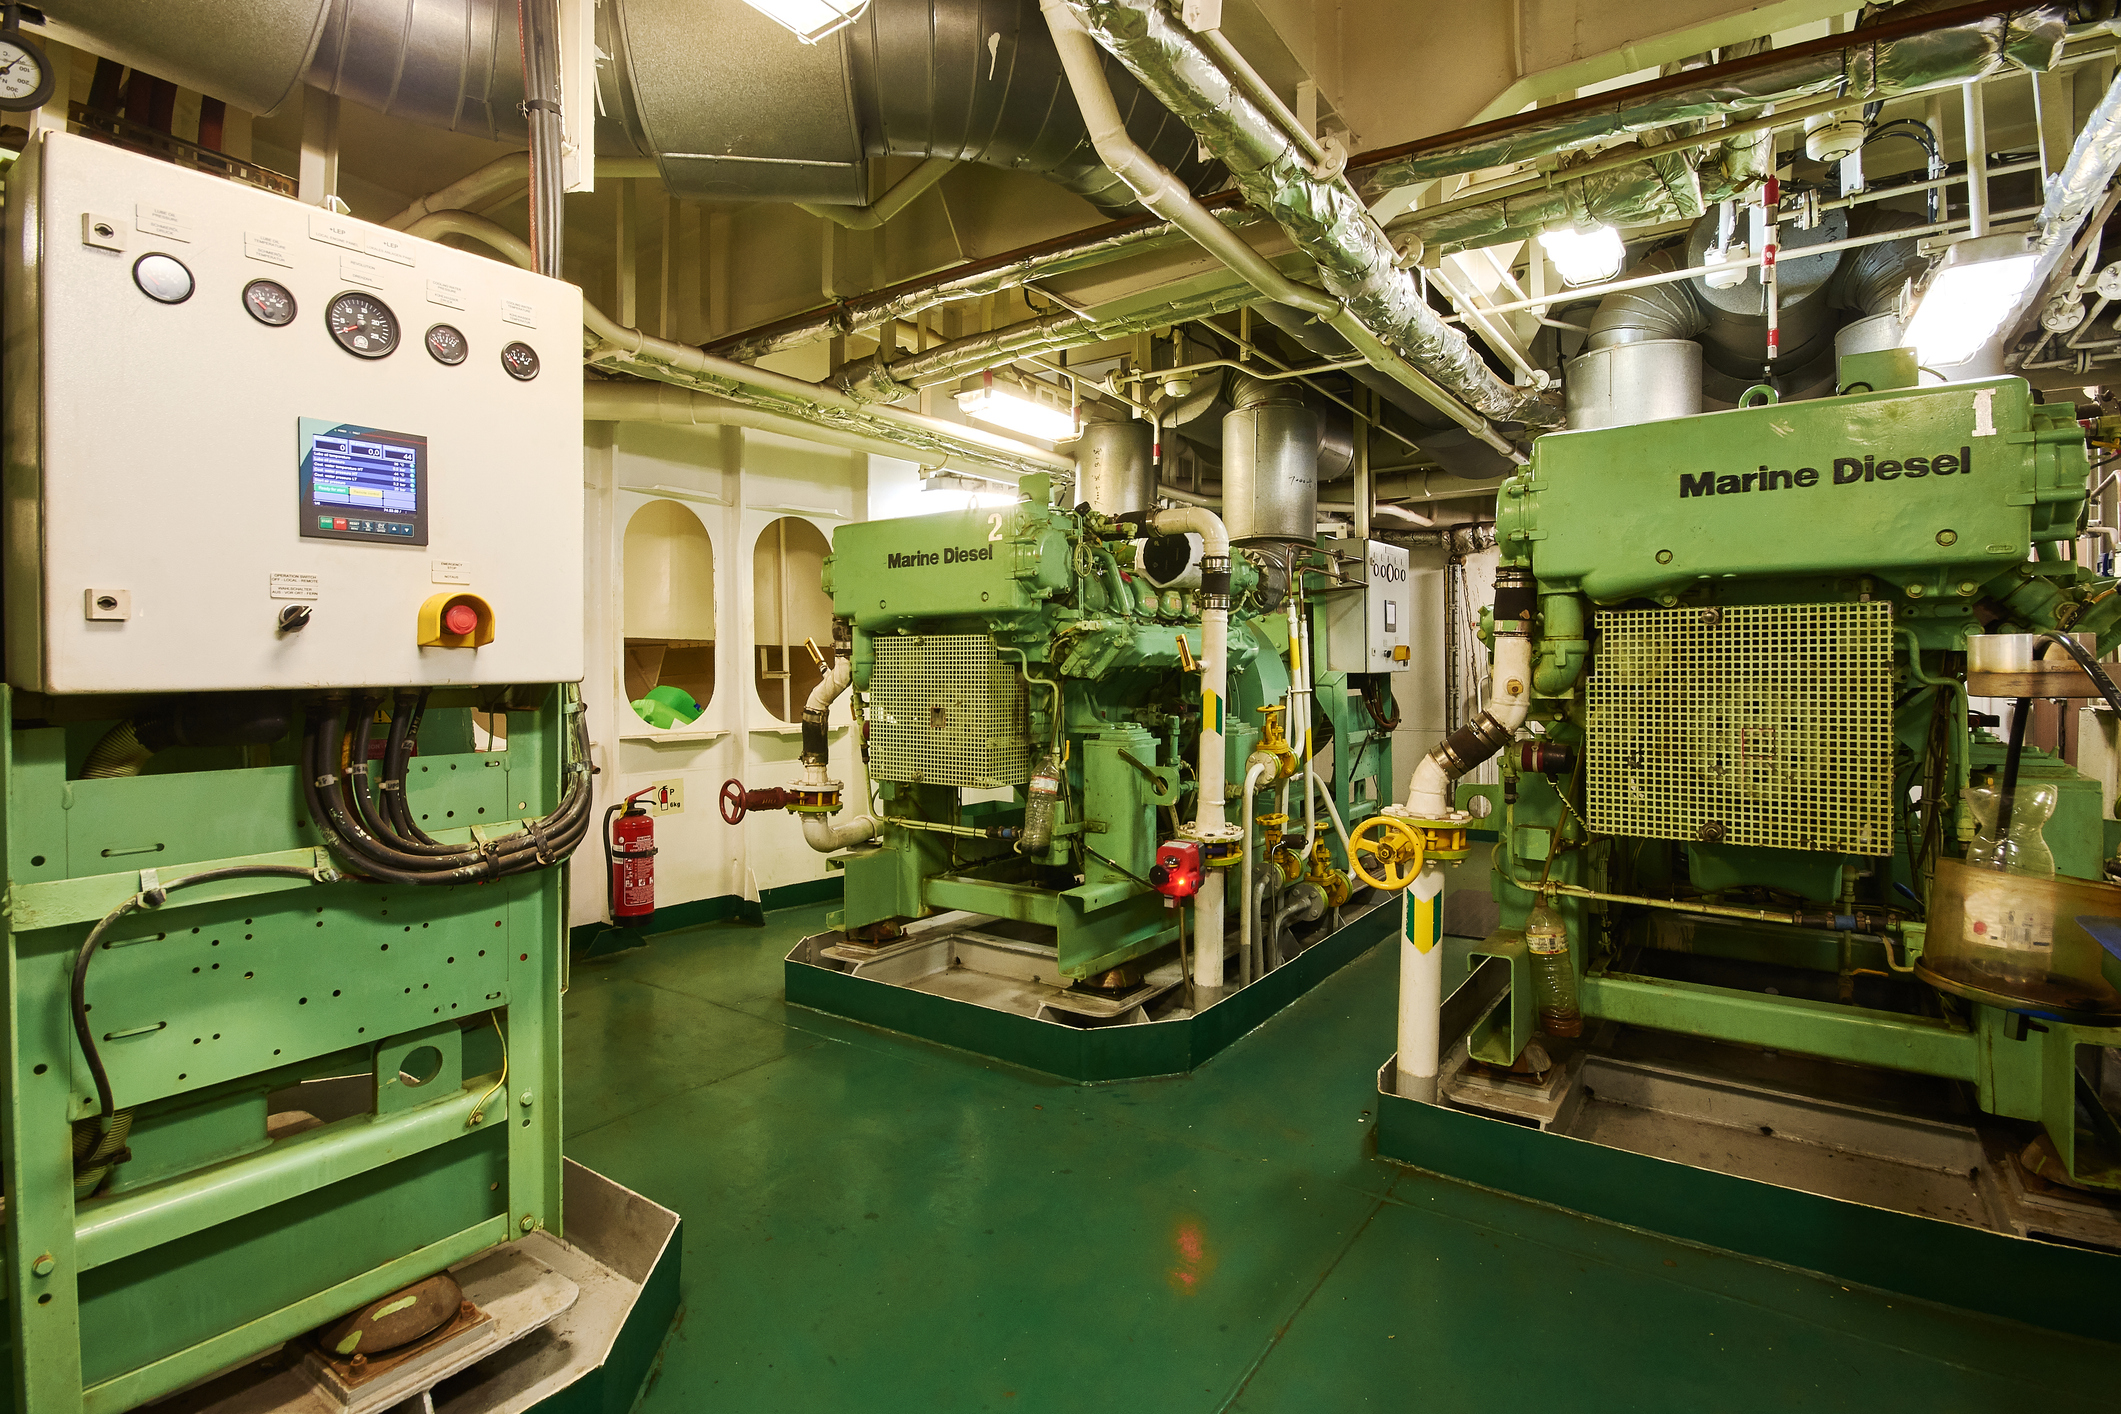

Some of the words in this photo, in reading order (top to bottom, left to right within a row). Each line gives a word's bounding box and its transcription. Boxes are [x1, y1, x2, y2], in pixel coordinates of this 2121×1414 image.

[17, 78, 30, 86] 200
[6, 85, 19, 93] 300
[1971, 388, 1998, 438] 1
[339, 444, 346, 452] 0
[367, 448, 380, 457] 0,0
[403, 453, 413, 461] 44
[1679, 465, 1819, 499] Marine
[1832, 446, 1972, 486] Diesel
[987, 512, 1004, 542] 2
[887, 549, 940, 570] Marine
[943, 543, 994, 565] Diesel
